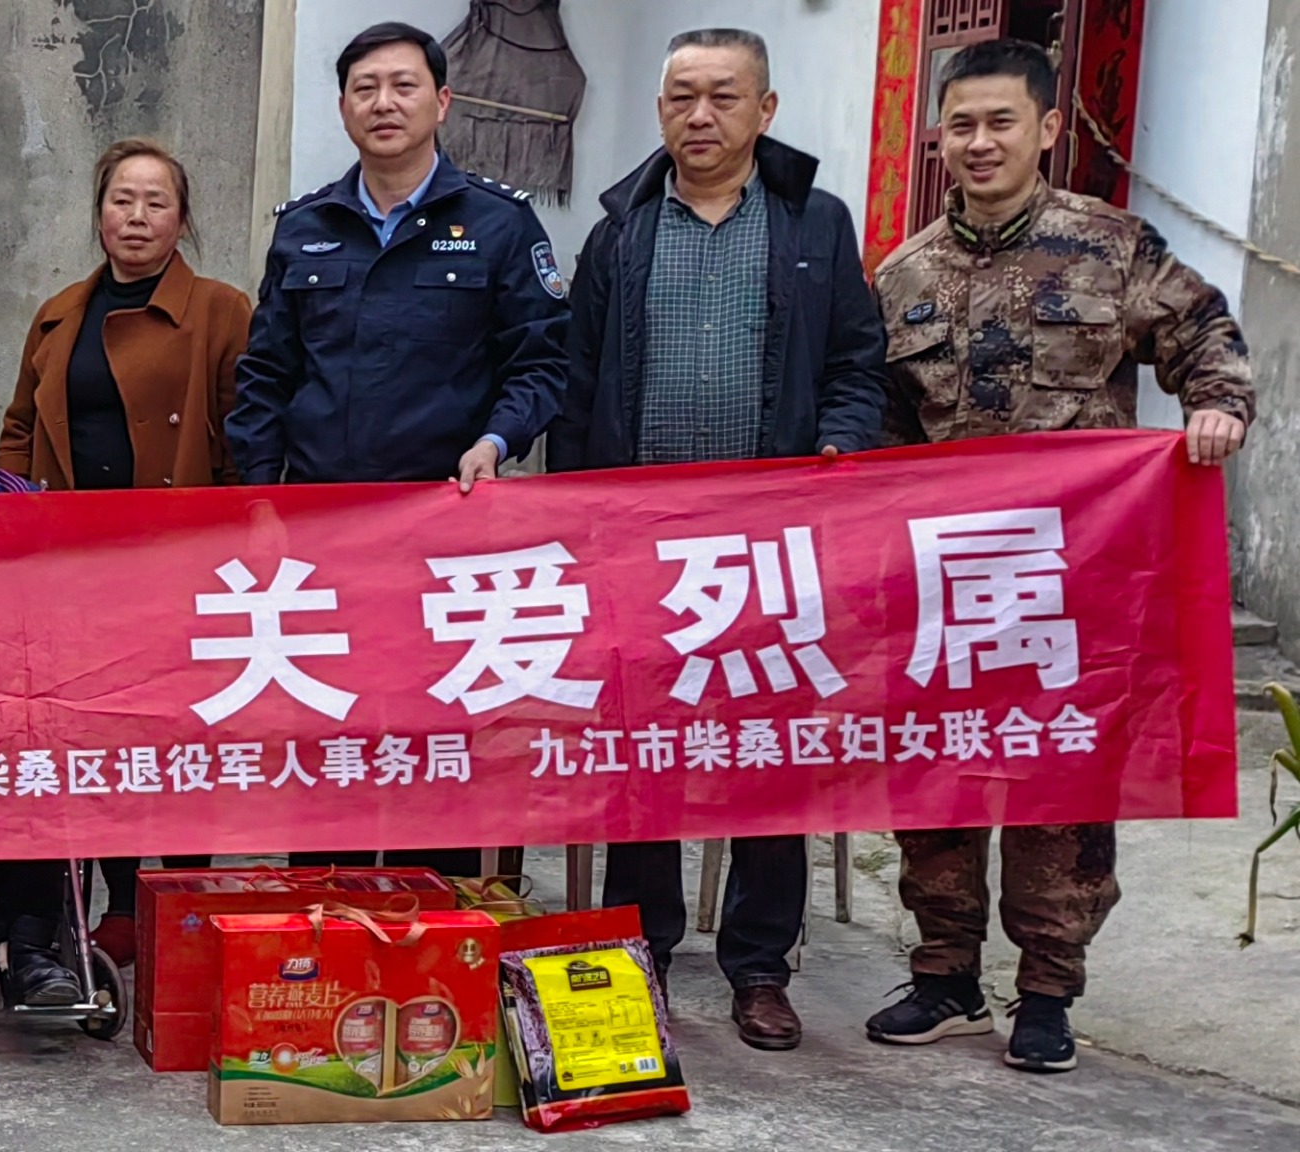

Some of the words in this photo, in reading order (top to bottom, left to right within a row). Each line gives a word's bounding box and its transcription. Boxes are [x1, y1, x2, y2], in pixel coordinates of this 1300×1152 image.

[431, 239, 477, 251] 023001
[189, 507, 1080, 727] 关爱烈属
[529, 703, 1098, 778] 九江市柴桑区妇女联合会
[248, 981, 341, 1009] 营养燕麦片
